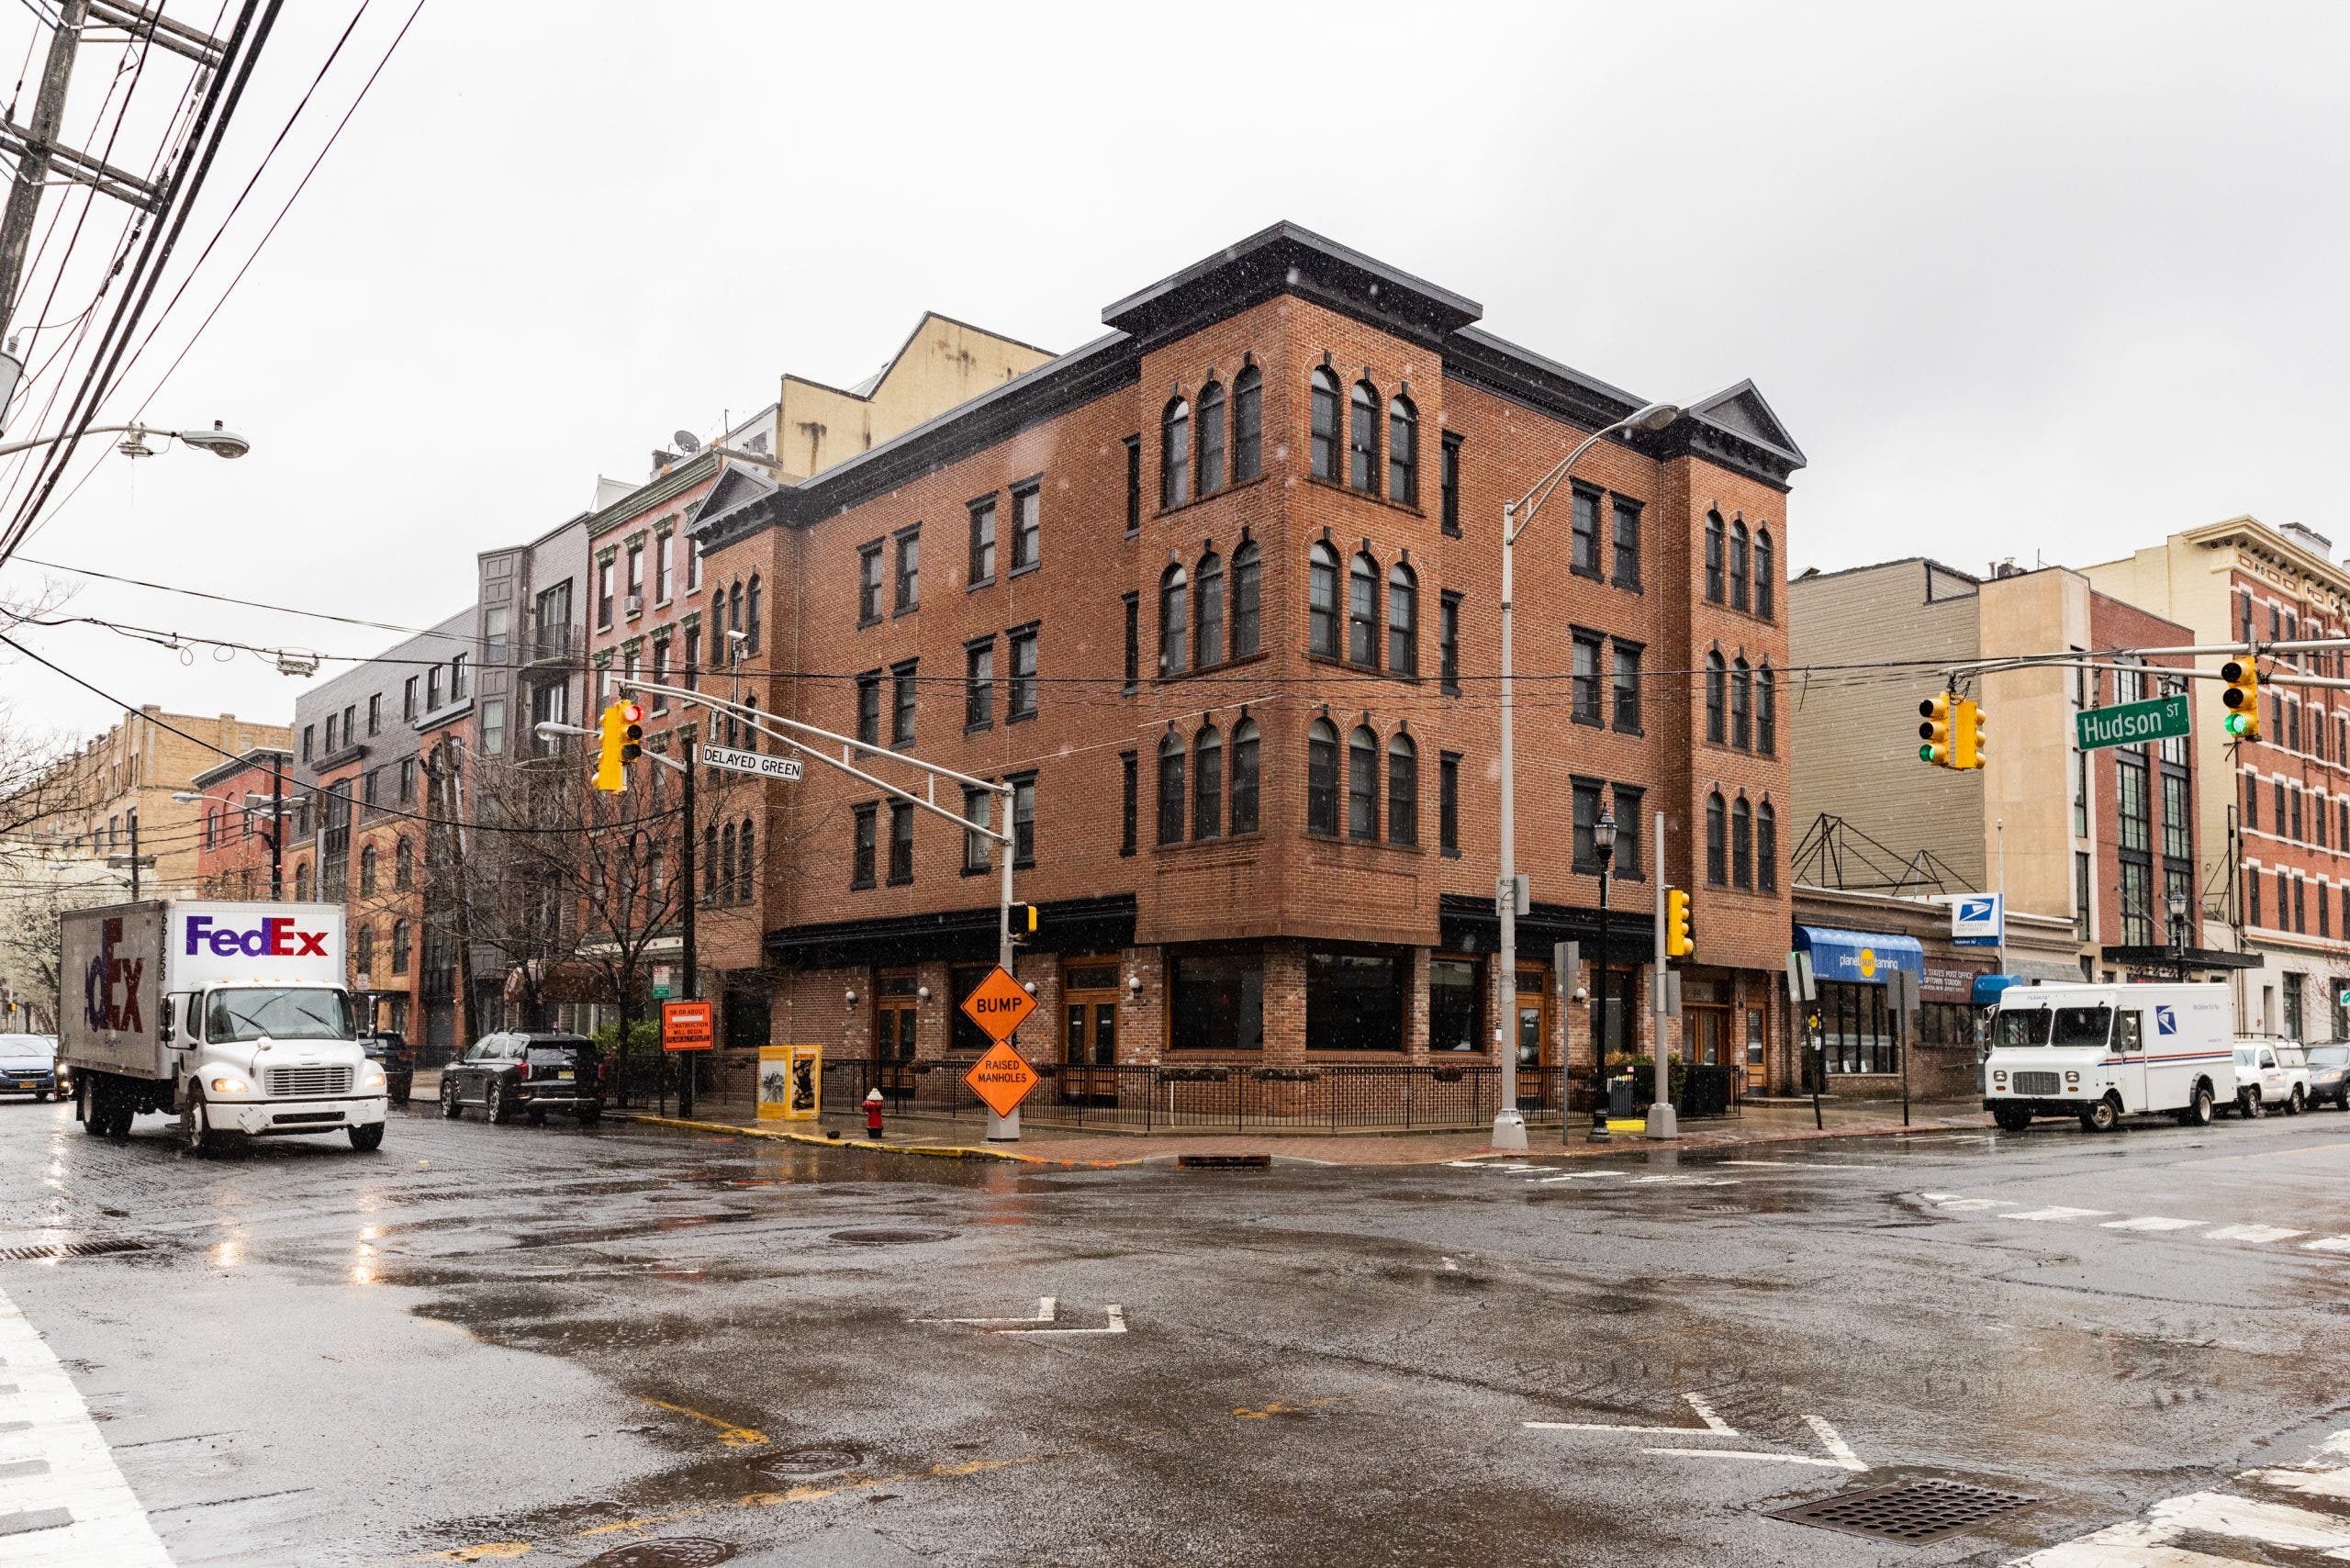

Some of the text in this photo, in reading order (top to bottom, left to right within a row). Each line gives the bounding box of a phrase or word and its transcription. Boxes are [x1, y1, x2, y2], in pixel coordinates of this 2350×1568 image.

[2084, 702, 2179, 742] Hudson ST
[704, 748, 800, 777] DELAYED GREEN
[185, 915, 329, 958] FedEx
[1840, 953, 1898, 970] planet sun tanning
[1923, 976, 1943, 985] UPTOWN
[1943, 978, 1962, 987] STATION
[1945, 970, 1957, 979] POST
[1957, 971, 1974, 980] OFFICE
[977, 997, 1023, 1014] BUMP
[985, 1060, 1020, 1070] RAISED
[978, 1073, 1027, 1082] MANHOLES
